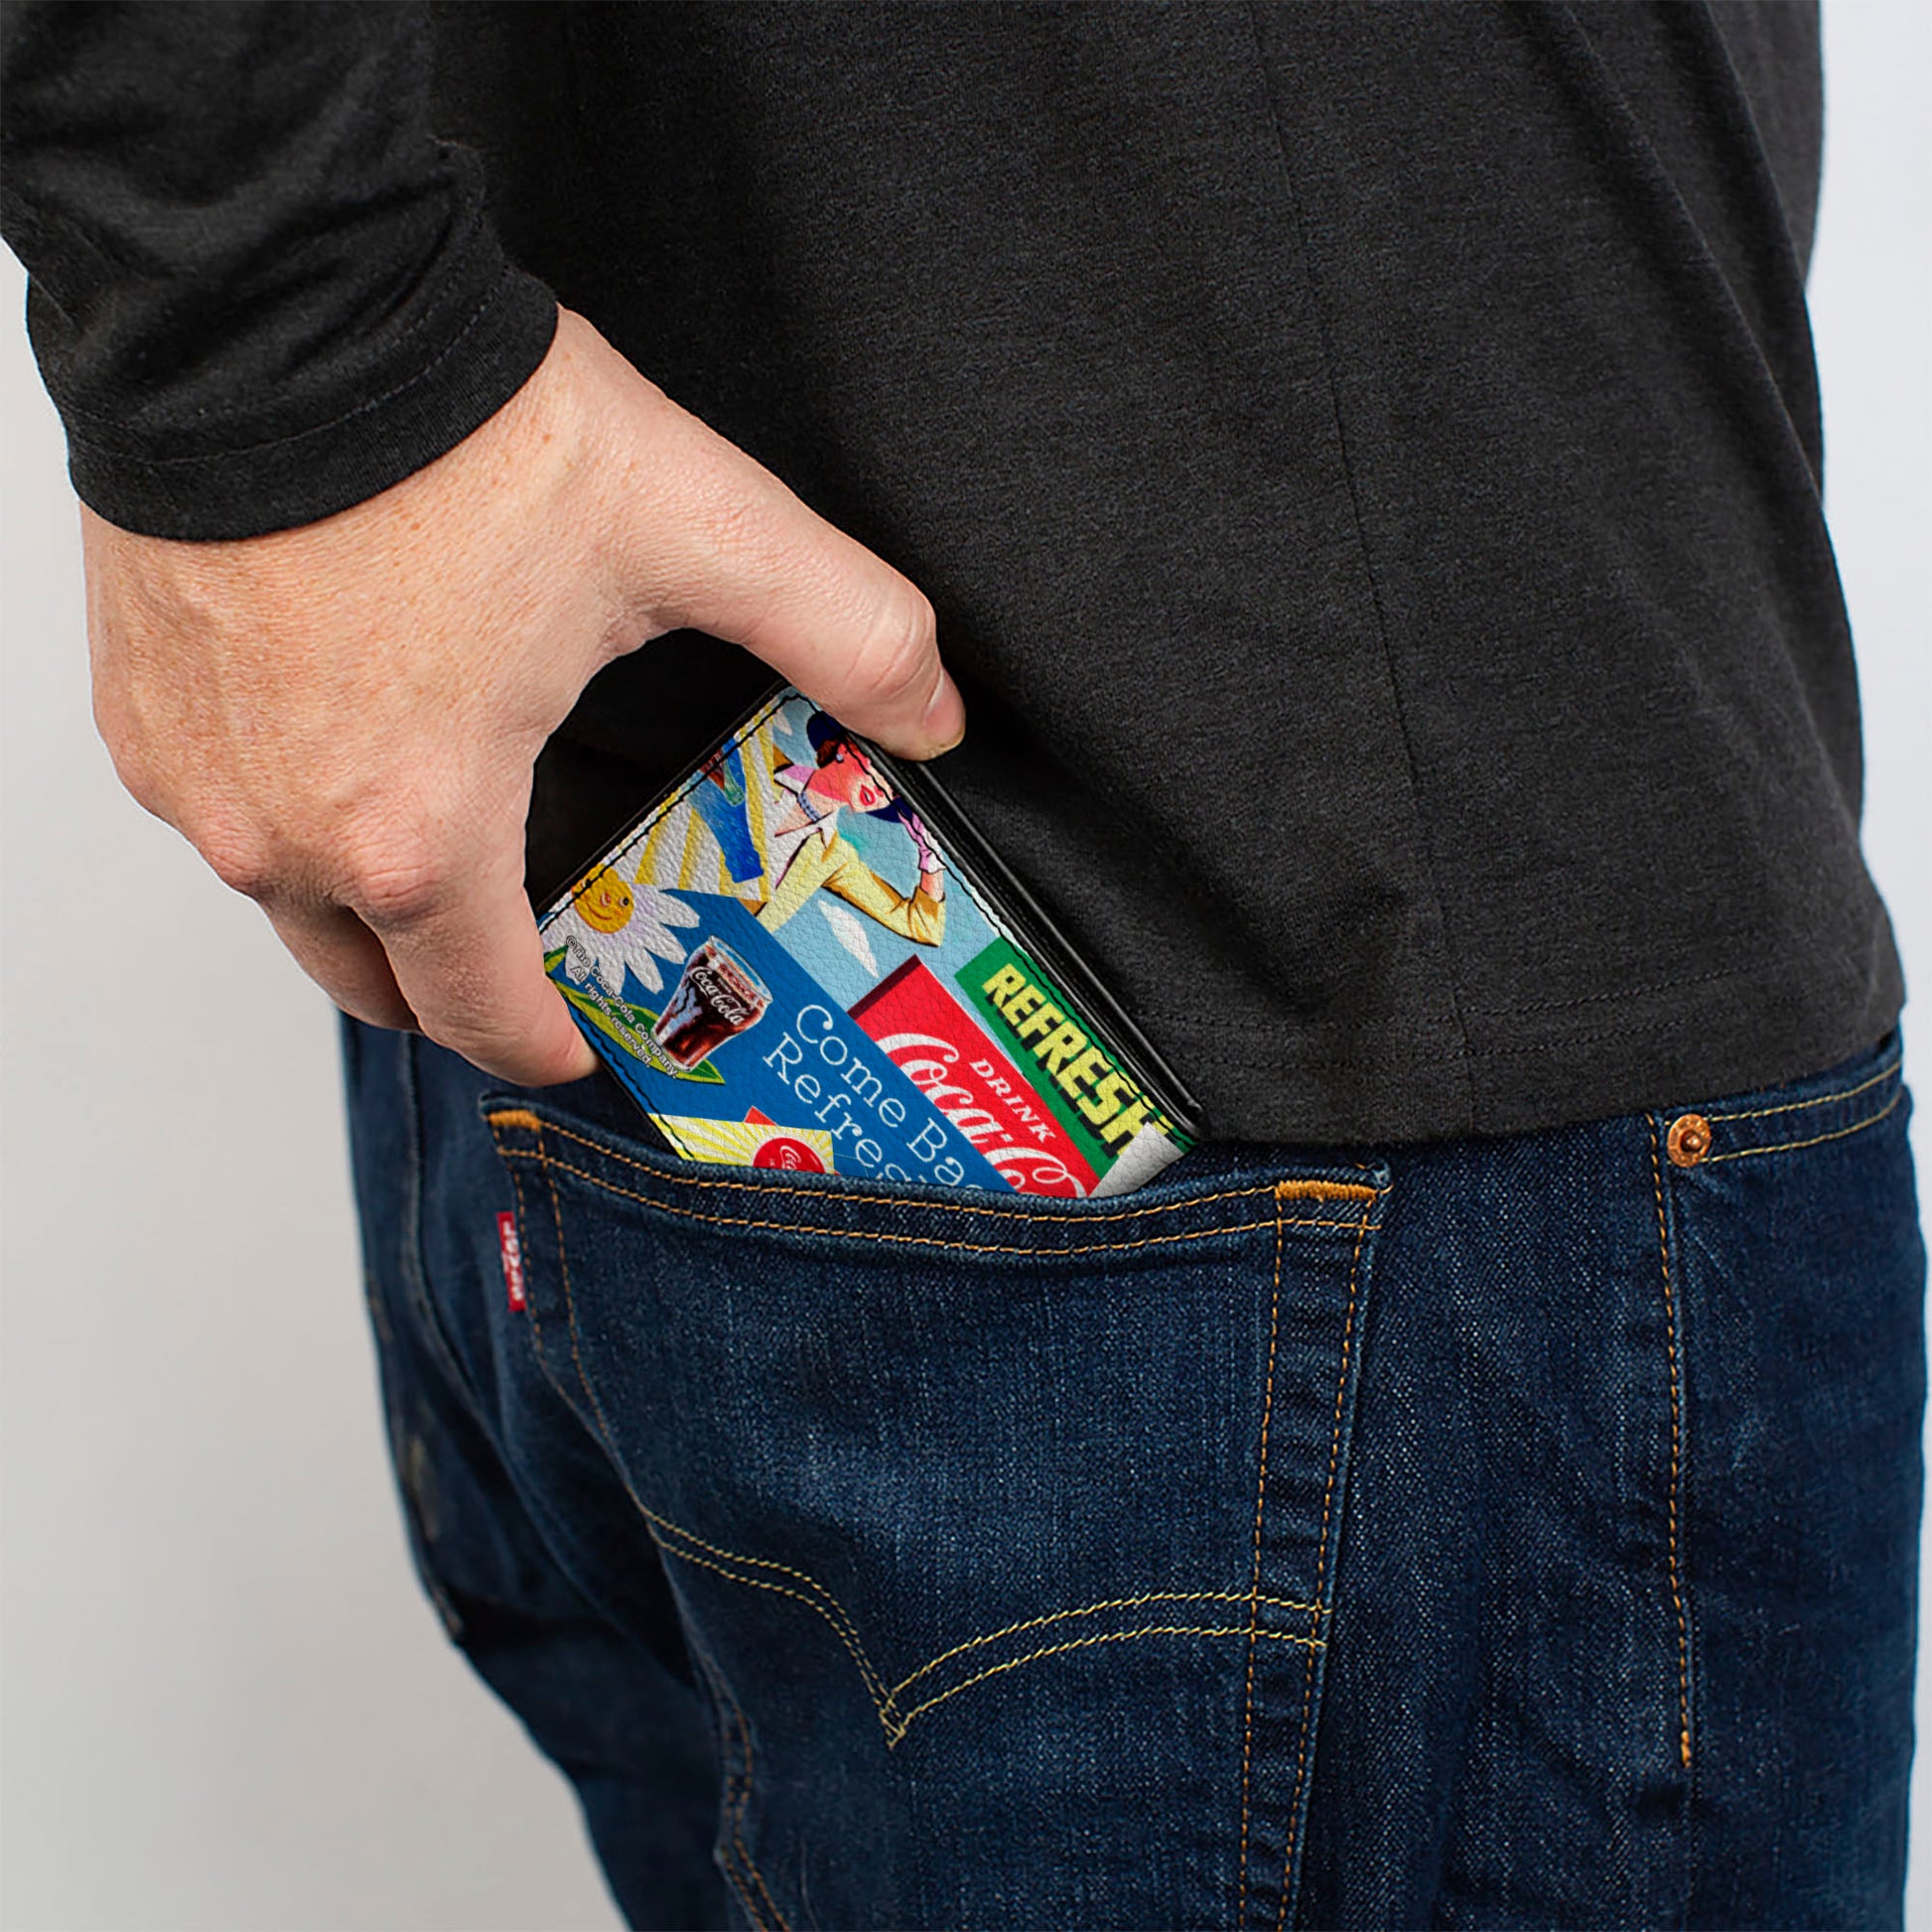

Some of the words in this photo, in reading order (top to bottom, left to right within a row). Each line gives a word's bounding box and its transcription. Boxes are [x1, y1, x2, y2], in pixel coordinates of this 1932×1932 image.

[570, 966, 588, 983] All
[585, 983, 612, 1017] rights
[611, 1016, 652, 1068] reserved.
[590, 965, 635, 1024] Coca-Cola
[634, 1023, 678, 1078] Company.
[796, 1005, 905, 1128] Come
[906, 1117, 983, 1189] Ba
[969, 1058, 1056, 1143] DRINK
